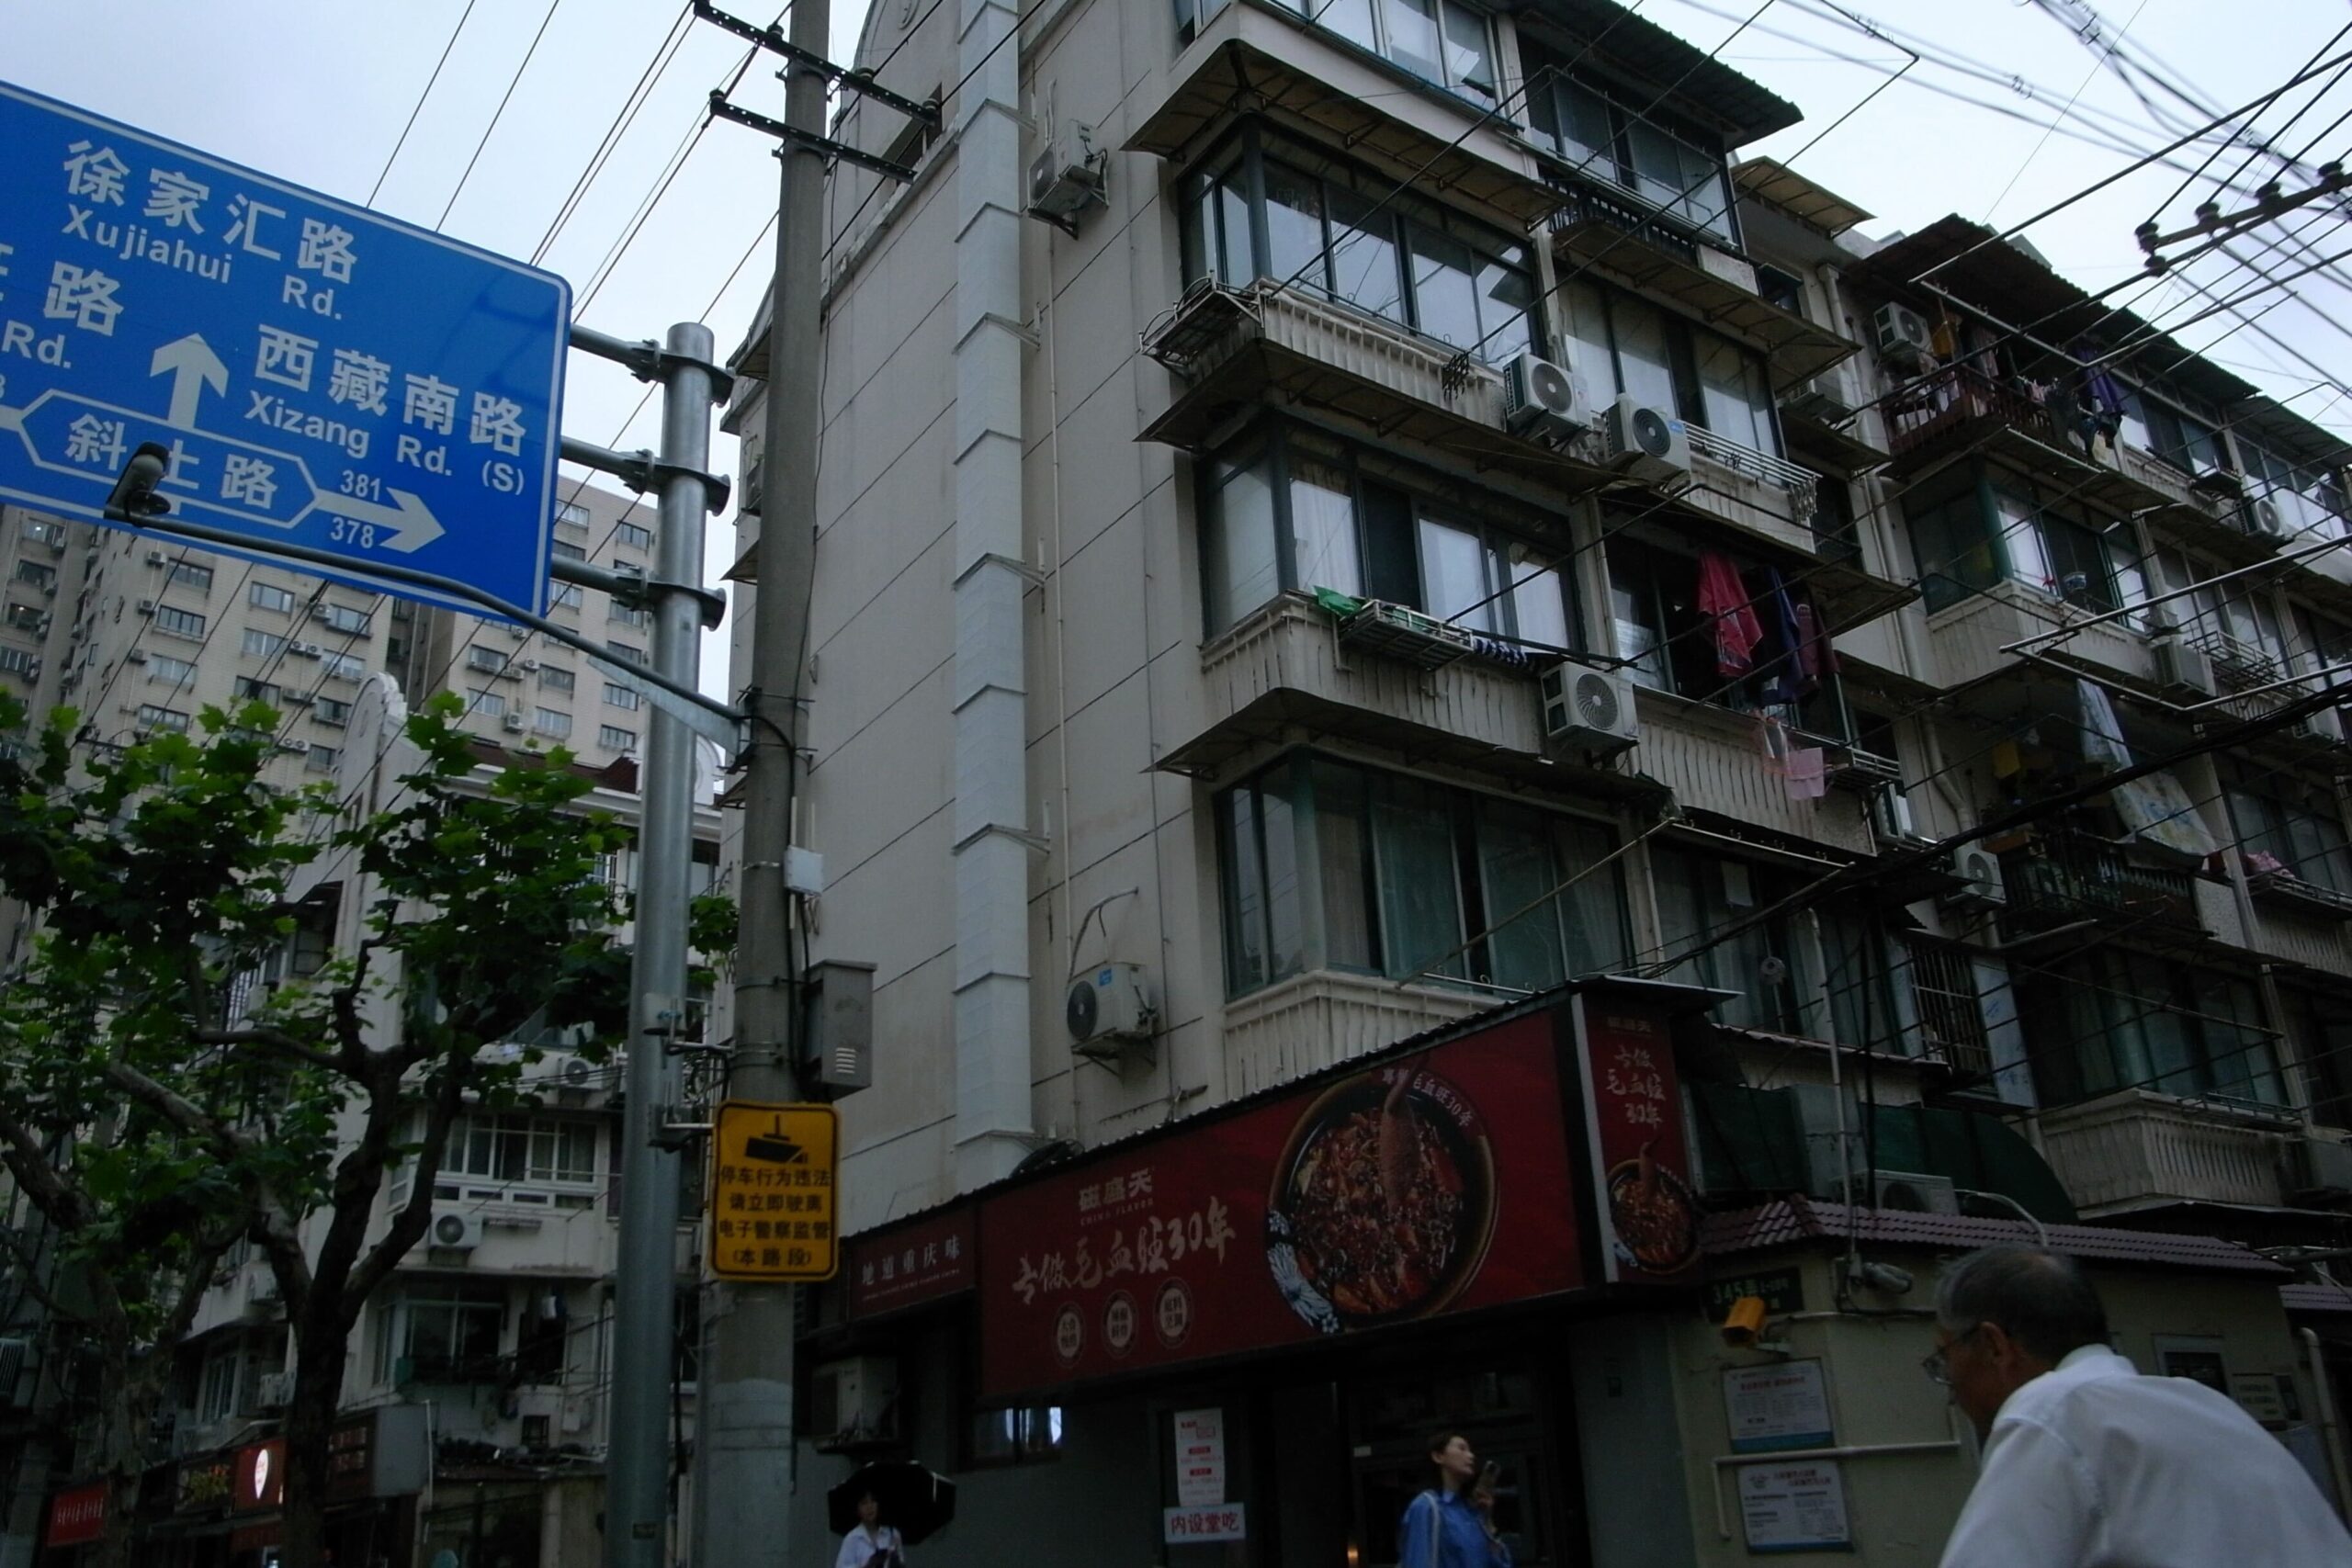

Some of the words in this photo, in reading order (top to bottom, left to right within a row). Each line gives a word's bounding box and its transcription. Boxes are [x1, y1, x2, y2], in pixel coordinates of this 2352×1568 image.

[62, 140, 357, 285] 徐家汇路
[62, 204, 232, 284] Xujiahui
[282, 275, 343, 321] Rd.
[2, 320, 73, 369] Rd.
[254, 323, 526, 457] 西藏南路
[244, 390, 369, 459] Xizang
[396, 434, 453, 476] Rd.
[481, 459, 525, 496] (S)
[340, 469, 381, 501] 381
[331, 516, 374, 549] 378
[721, 1166, 831, 1187] 停车行为违法
[862, 1234, 960, 1286] 地道重庆味
[1171, 1511, 1239, 1536] 内设堂吃
